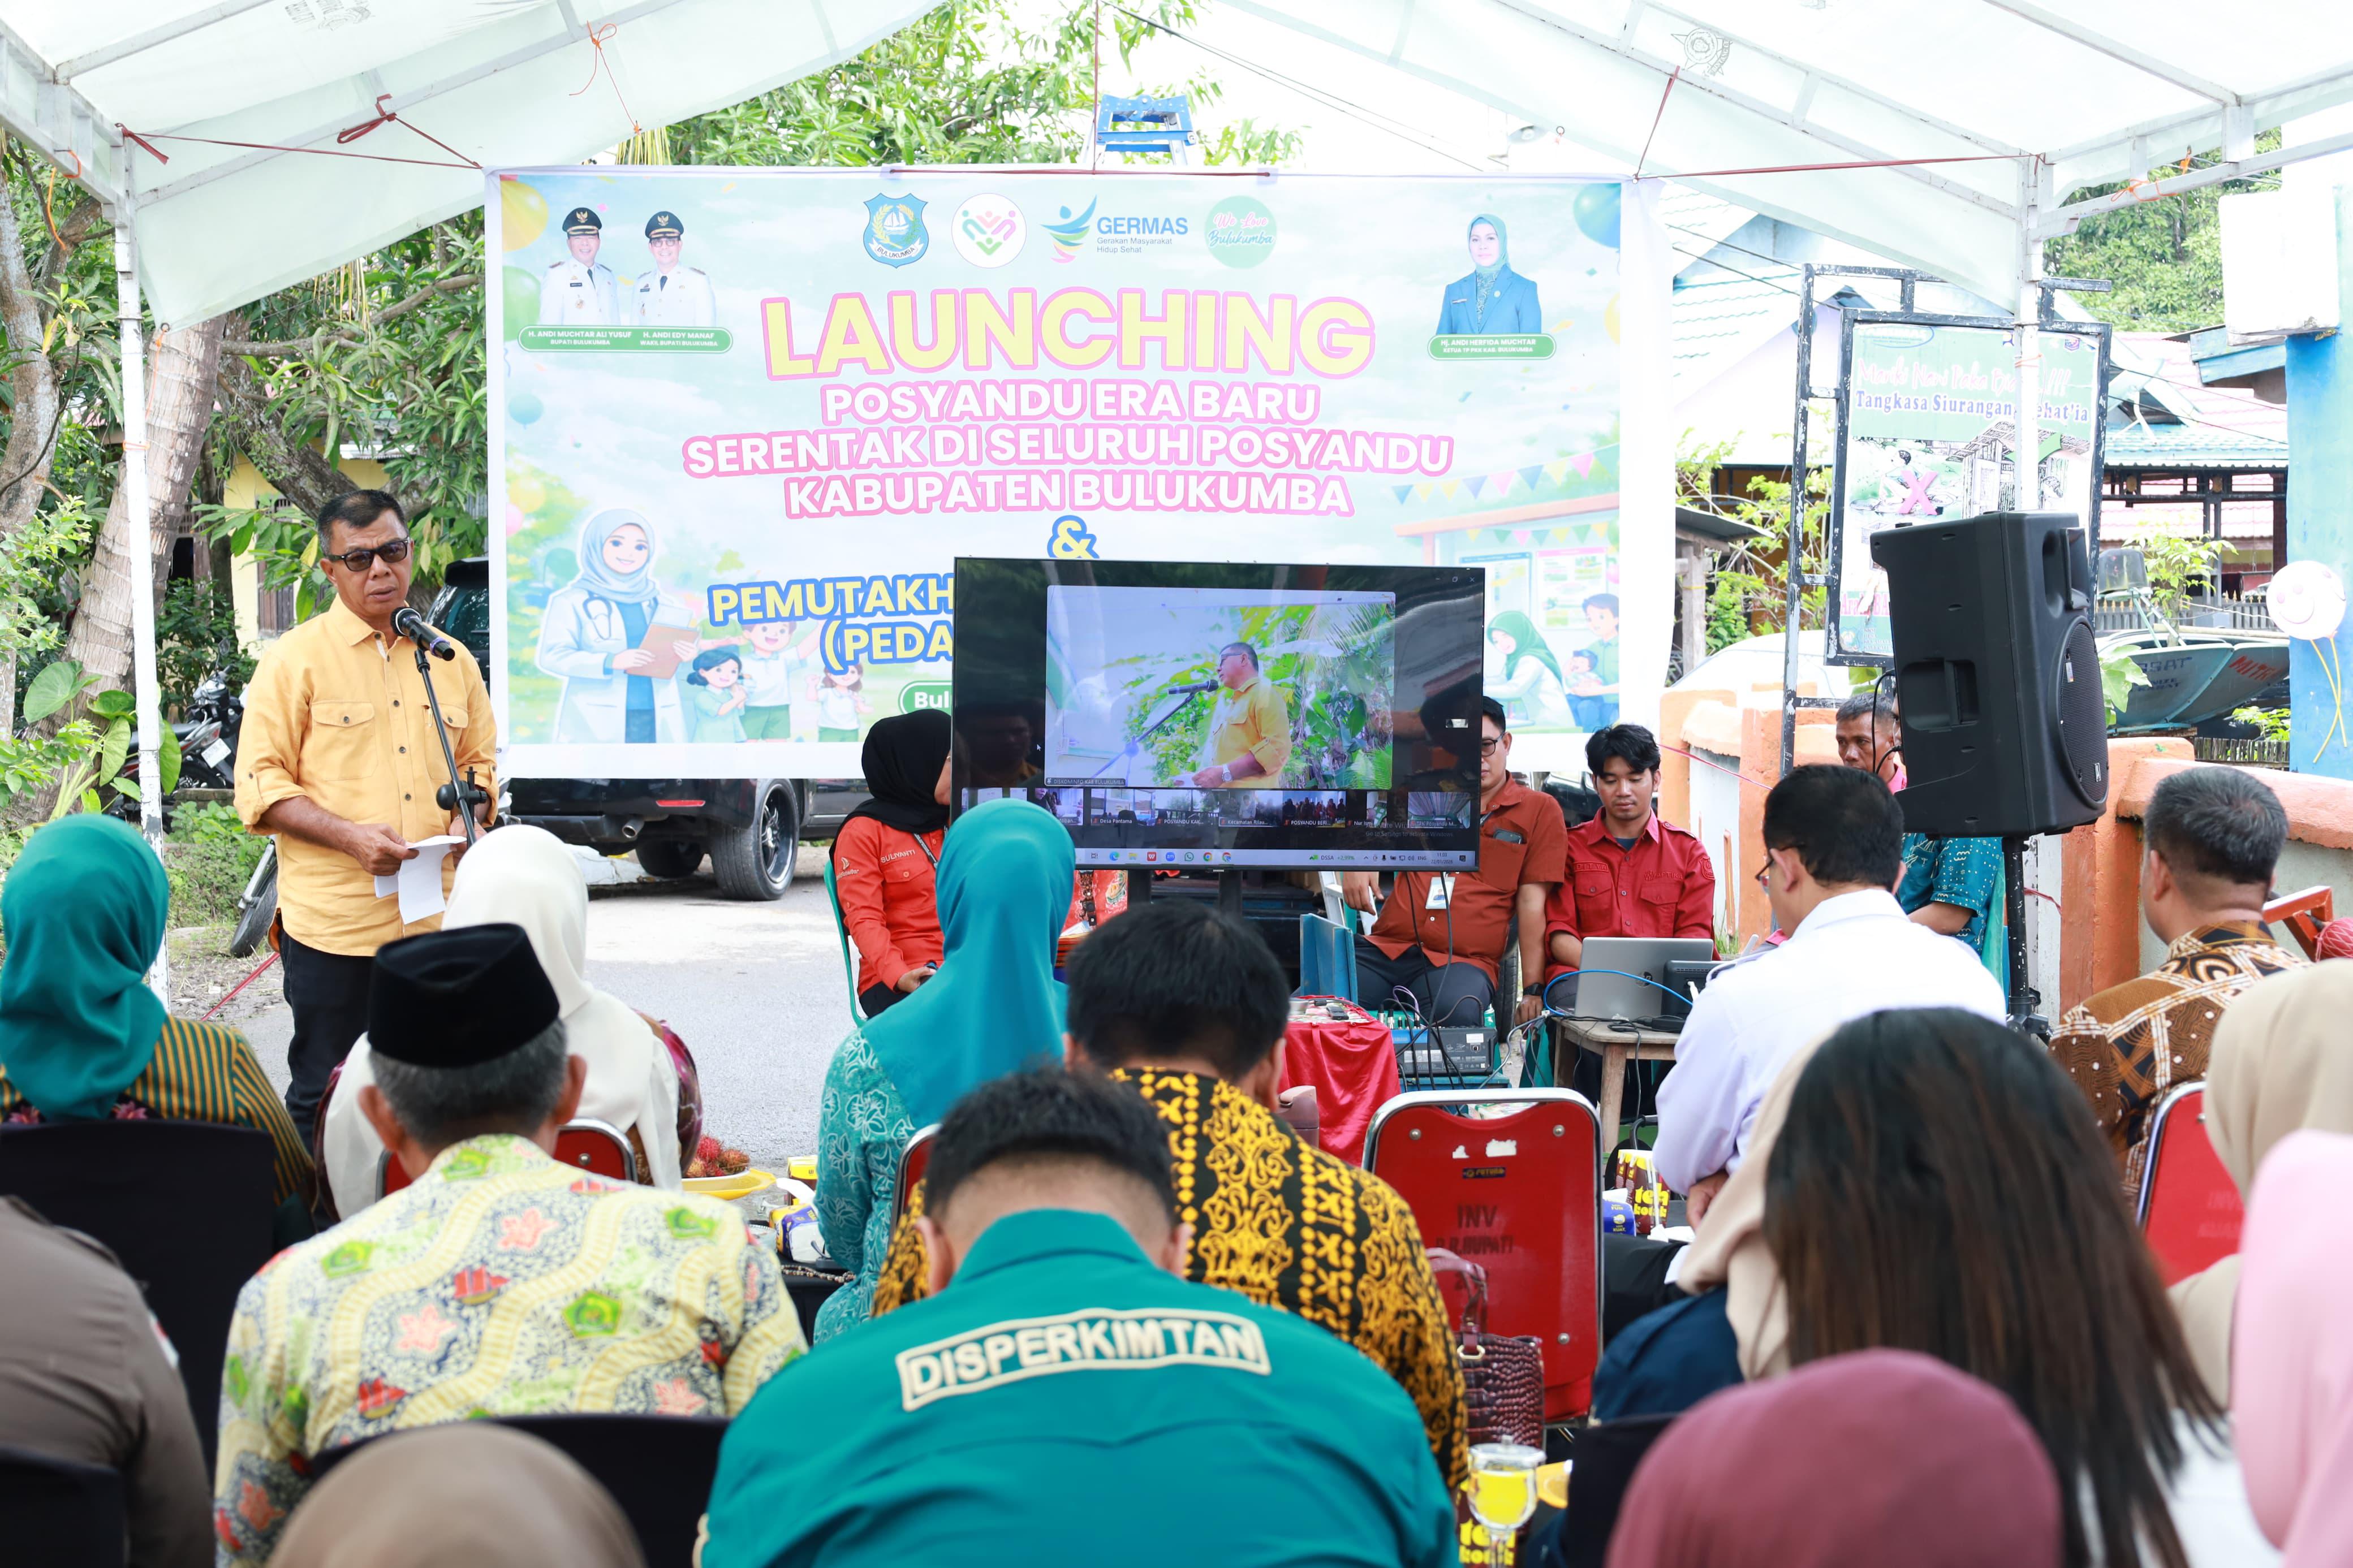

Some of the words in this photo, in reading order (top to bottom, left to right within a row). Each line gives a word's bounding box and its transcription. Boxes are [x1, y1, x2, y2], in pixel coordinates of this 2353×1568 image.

[1096, 217, 1188, 235] GERMAS
[1213, 212, 1236, 228] We
[1240, 212, 1268, 228] Love
[1130, 237, 1173, 245] Masyarakat
[1208, 230, 1274, 248] Bulukumba
[877, 246, 916, 258] BULUKUMBA
[761, 286, 1375, 381] LAUNCHING
[820, 378, 1087, 426] POSYANDU
[1091, 379, 1187, 421] ERA
[1188, 380, 1321, 426] BARU
[1856, 390, 1928, 413] Tangkasa
[1933, 394, 2018, 418] Siurangan
[2037, 401, 2088, 422] ehat'ia
[683, 424, 928, 479] SERENTAK
[929, 424, 982, 468] DI
[985, 423, 1193, 467] SELURUH
[1195, 425, 1454, 477] POSYANDU
[784, 470, 1068, 519] KABUPATEN
[1068, 470, 1355, 517] BULUKUMBA
[1047, 515, 1098, 559] &
[880, 849, 916, 863] SULIYANTI
[1457, 1204, 1498, 1229] INV
[1634, 1203, 1667, 1218] kotk
[909, 1318, 1259, 1397] DISPERKIMTAN
